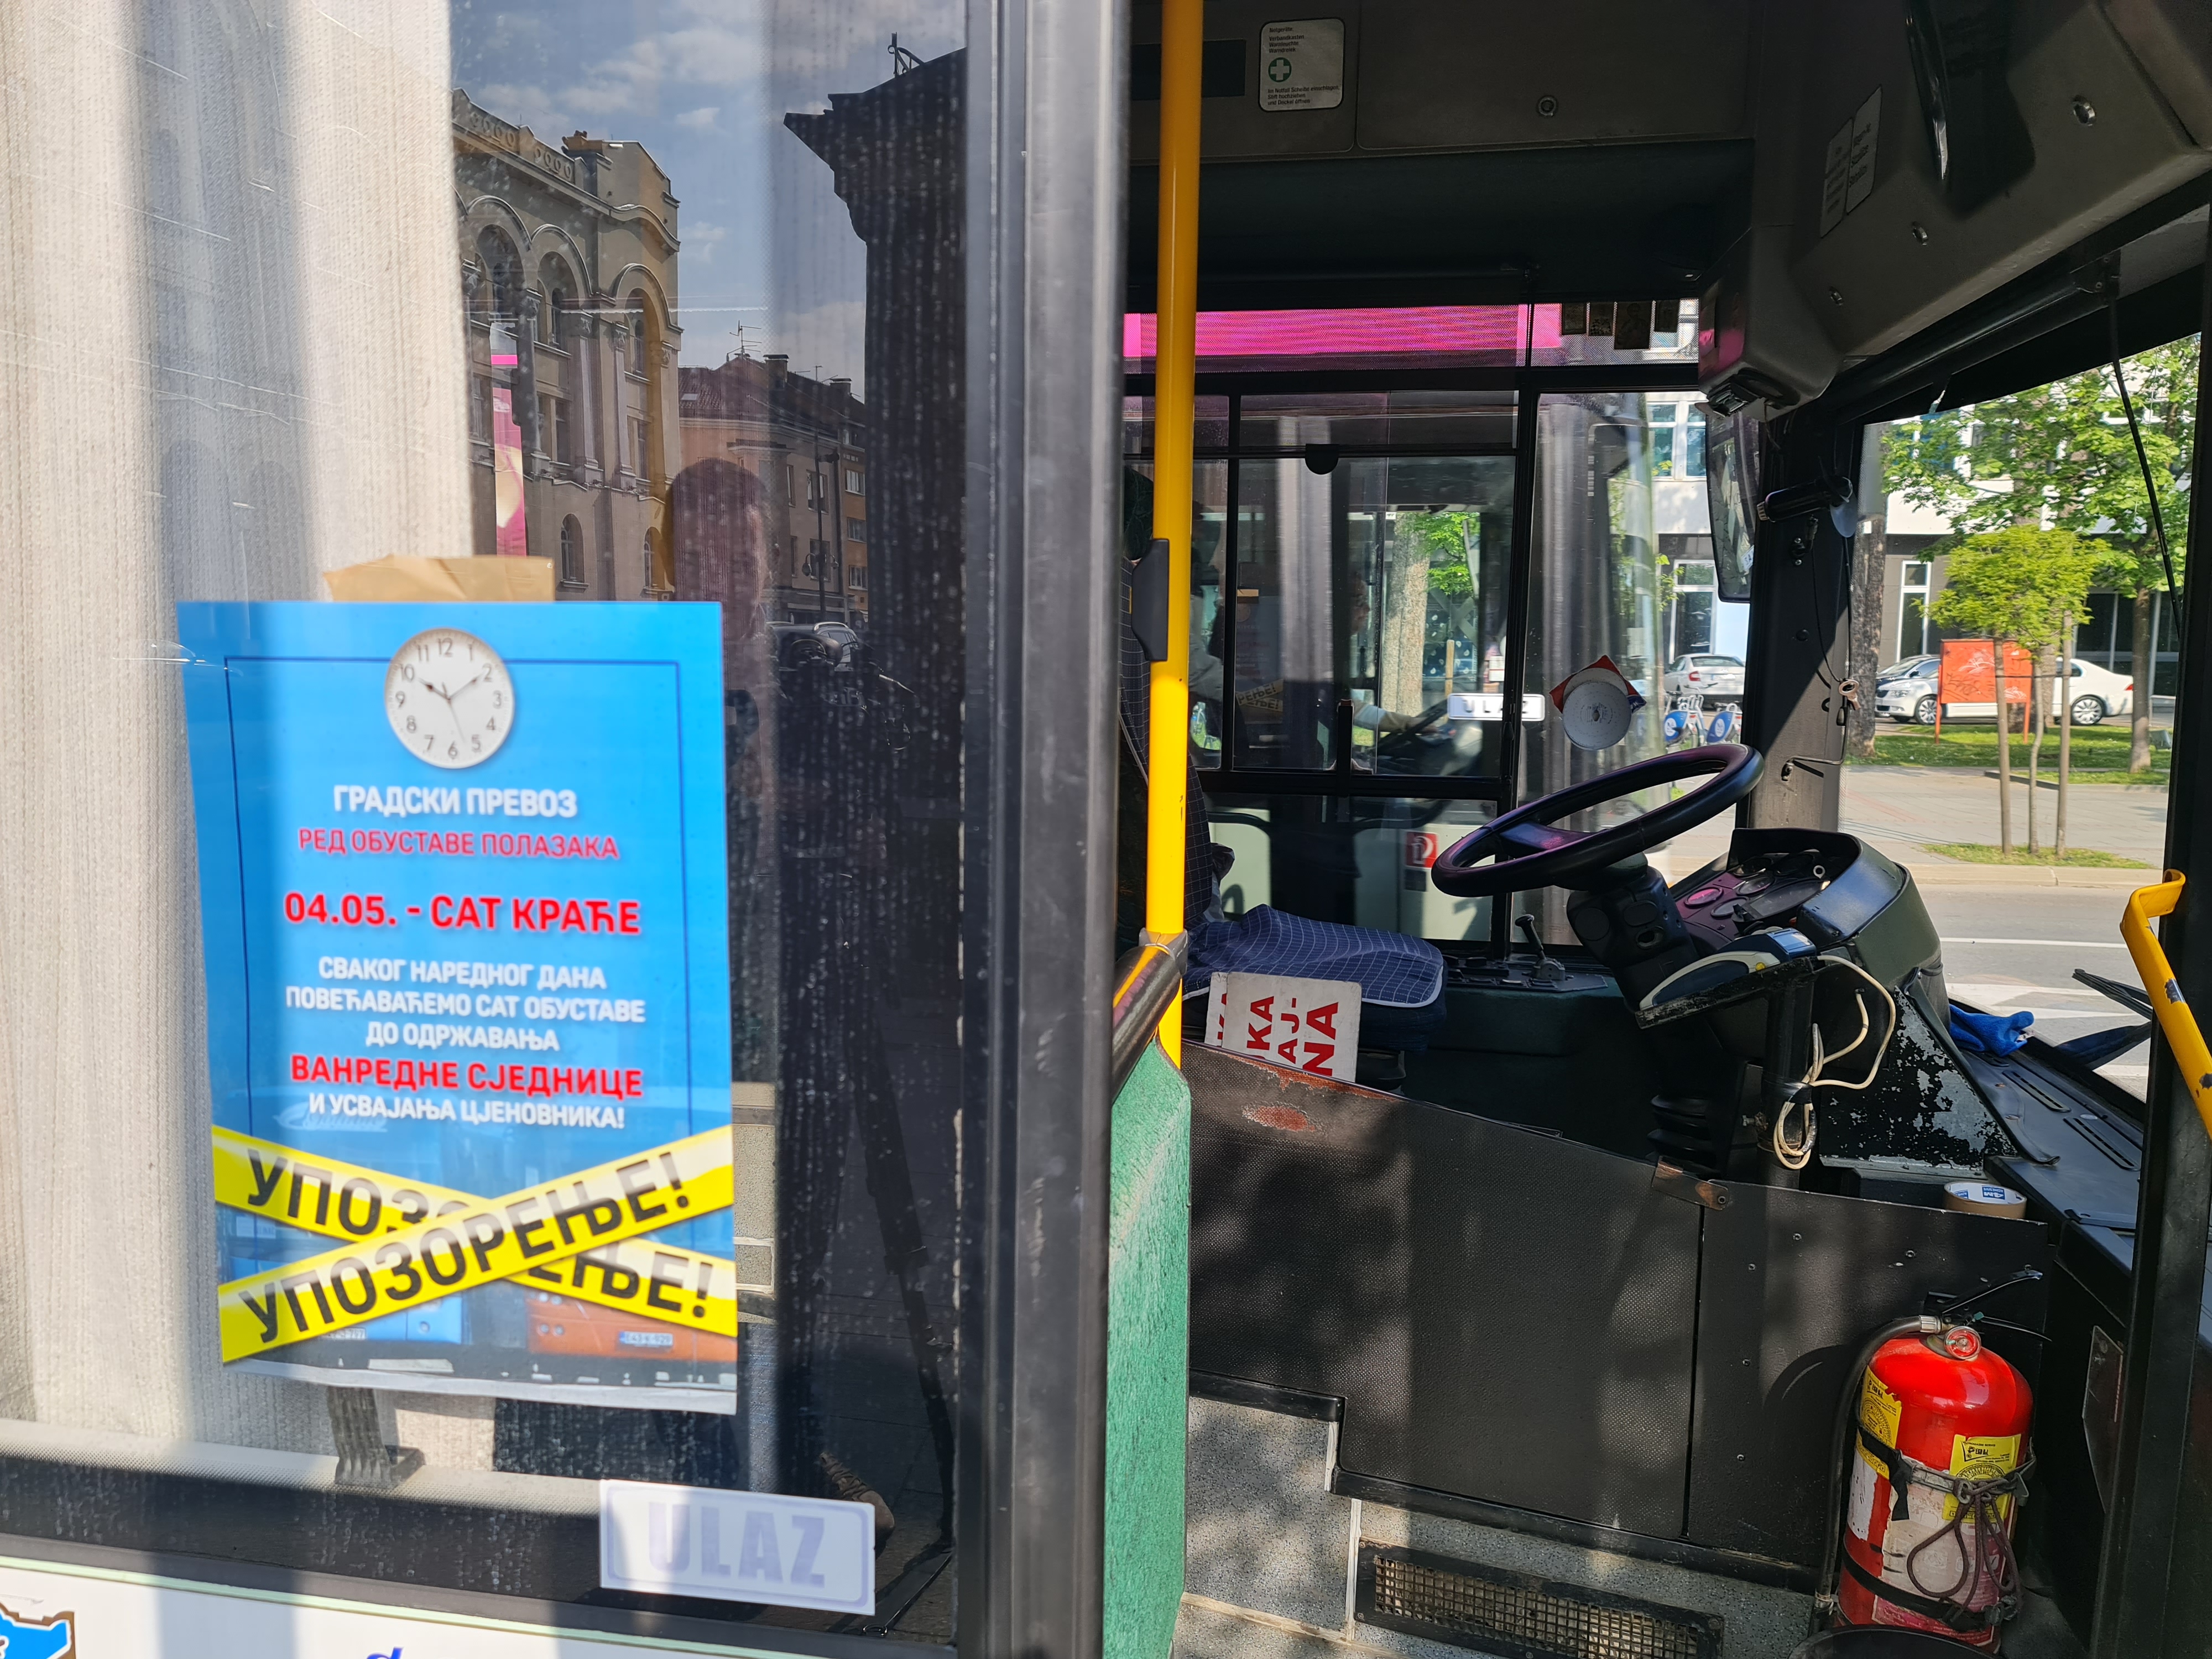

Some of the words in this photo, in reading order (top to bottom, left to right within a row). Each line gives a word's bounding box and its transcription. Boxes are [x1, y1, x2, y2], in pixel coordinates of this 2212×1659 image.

[418, 644, 429, 662] 11
[438, 637, 453, 657] 12
[400, 664, 415, 682] 10
[482, 663, 493, 682] 2
[395, 691, 405, 708] 9
[493, 691, 502, 708] 3
[406, 715, 416, 733] 8
[486, 717, 496, 731] 4
[424, 734, 434, 751] 7
[448, 741, 458, 759] 6
[472, 734, 481, 753] 5
[333, 785, 460, 817] ГРАДСКИ
[466, 788, 577, 818] ПРЕВОЗ
[299, 828, 345, 854] РЕД
[351, 830, 474, 855] ОБУСТАВЕ
[482, 833, 620, 859] ПОЛАЗАКА
[284, 893, 397, 926] 04.05.
[431, 896, 502, 928] САТ
[512, 899, 640, 934] КРАЋЕ
[319, 957, 406, 982] СВАКОГ
[411, 960, 534, 990] НАРЕДНОГ
[538, 965, 607, 992] ДАНА
[286, 987, 469, 1016] ПОВЕЋАВАЋЕМО
[476, 993, 519, 1018] САТ
[524, 995, 645, 1022] ОБУСТАВЕ
[366, 1022, 399, 1047] ДО
[403, 1023, 559, 1051] ОДРЖАВАЊА
[1246, 996, 1274, 1059] KA
[1302, 1002, 1338, 1076] NA
[290, 1055, 458, 1091] ВАНРЕДНЕ
[467, 1063, 643, 1101] СЈЕДНИЦЕ
[309, 1093, 325, 1115] И
[330, 1094, 456, 1121] УСВАЈАЊА
[461, 1103, 624, 1129] ЦЈЕНОВНИКА!
[239, 1152, 689, 1343] УПОЗОРЕЊЕ!
[649, 1501, 826, 1589] ULAZ
